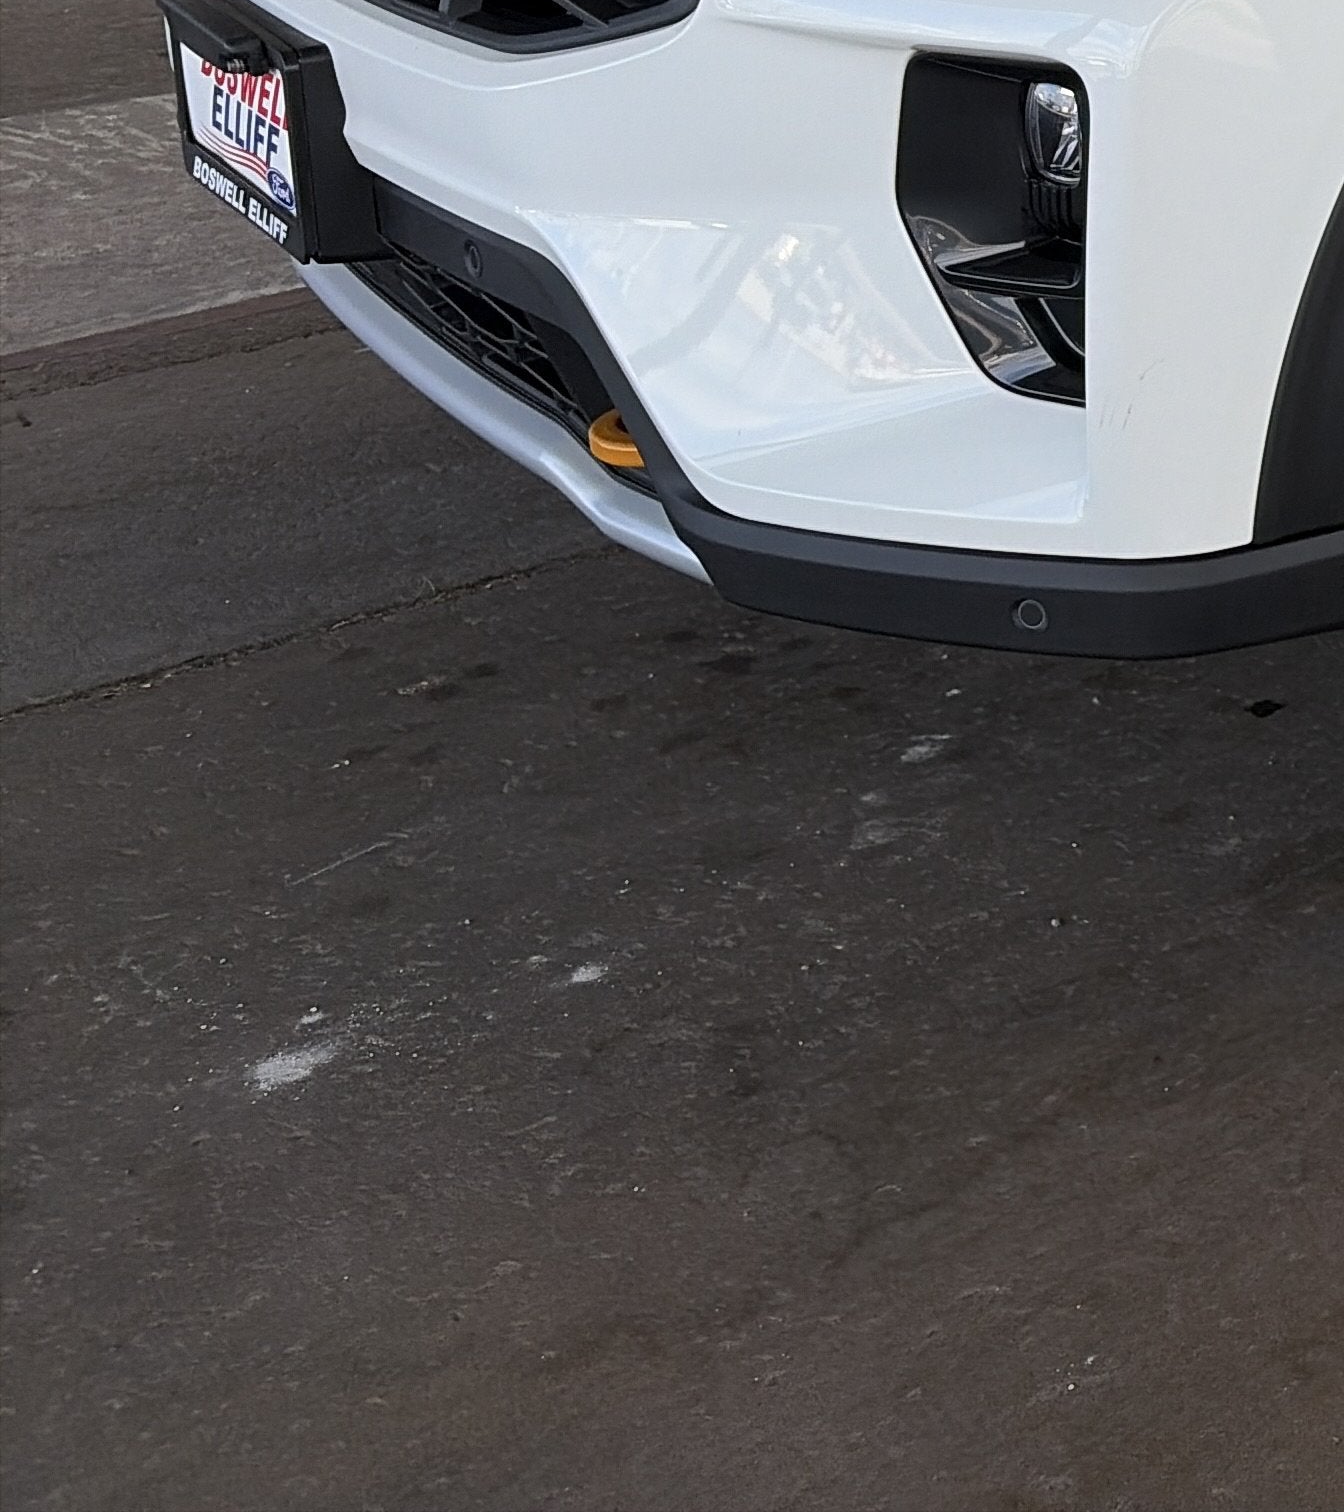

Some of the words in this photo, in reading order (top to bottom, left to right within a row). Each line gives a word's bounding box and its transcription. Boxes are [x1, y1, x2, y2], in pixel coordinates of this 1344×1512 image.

[212, 84, 280, 168] ELLIFF
[193, 155, 246, 215] BOSWELL
[248, 196, 289, 245] ELLIFF
